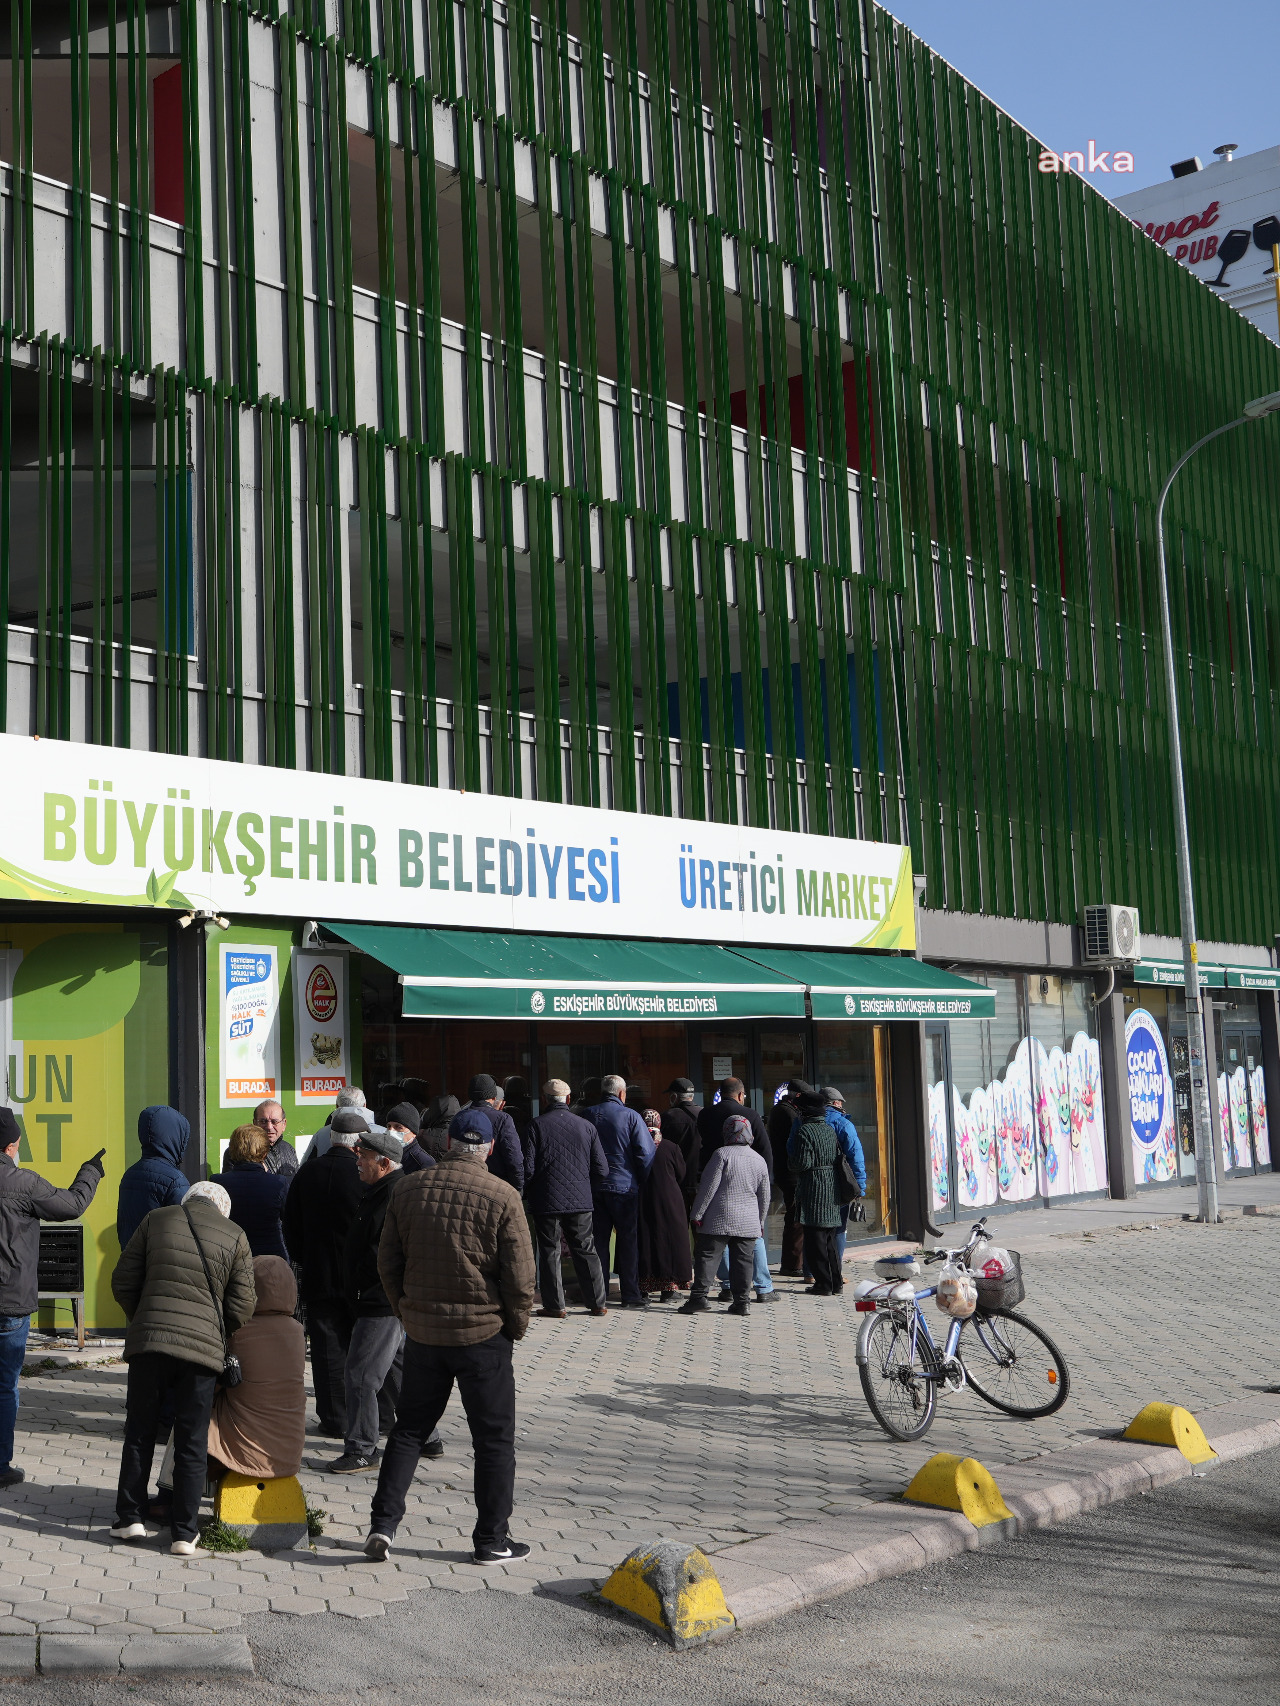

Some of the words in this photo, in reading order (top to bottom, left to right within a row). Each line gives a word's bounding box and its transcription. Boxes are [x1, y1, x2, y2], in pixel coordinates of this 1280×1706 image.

[1175, 235, 1219, 264] PUB
[43, 778, 378, 896] BÜYÜKŞEHİR
[399, 827, 621, 904] BELEDİYESİ
[679, 844, 786, 915] ÜRETİCİ
[796, 868, 893, 922] MARKET
[248, 999, 267, 1008] DOĞAL
[553, 993, 605, 1015] ESKİŞEHİR
[607, 994, 666, 1014] BÜYÜKŞEHİR
[668, 995, 718, 1012] BELEDİYESİ
[860, 998, 895, 1015] ESKİŞEHİR
[896, 998, 935, 1016] BÜYÜKŞEHİR
[937, 1000, 971, 1013] BELEDİYESİ
[232, 1010, 252, 1020] HALK
[231, 1020, 252, 1036] SÜT
[229, 1081, 271, 1094] BURADA
[303, 1079, 343, 1091] BURADA
